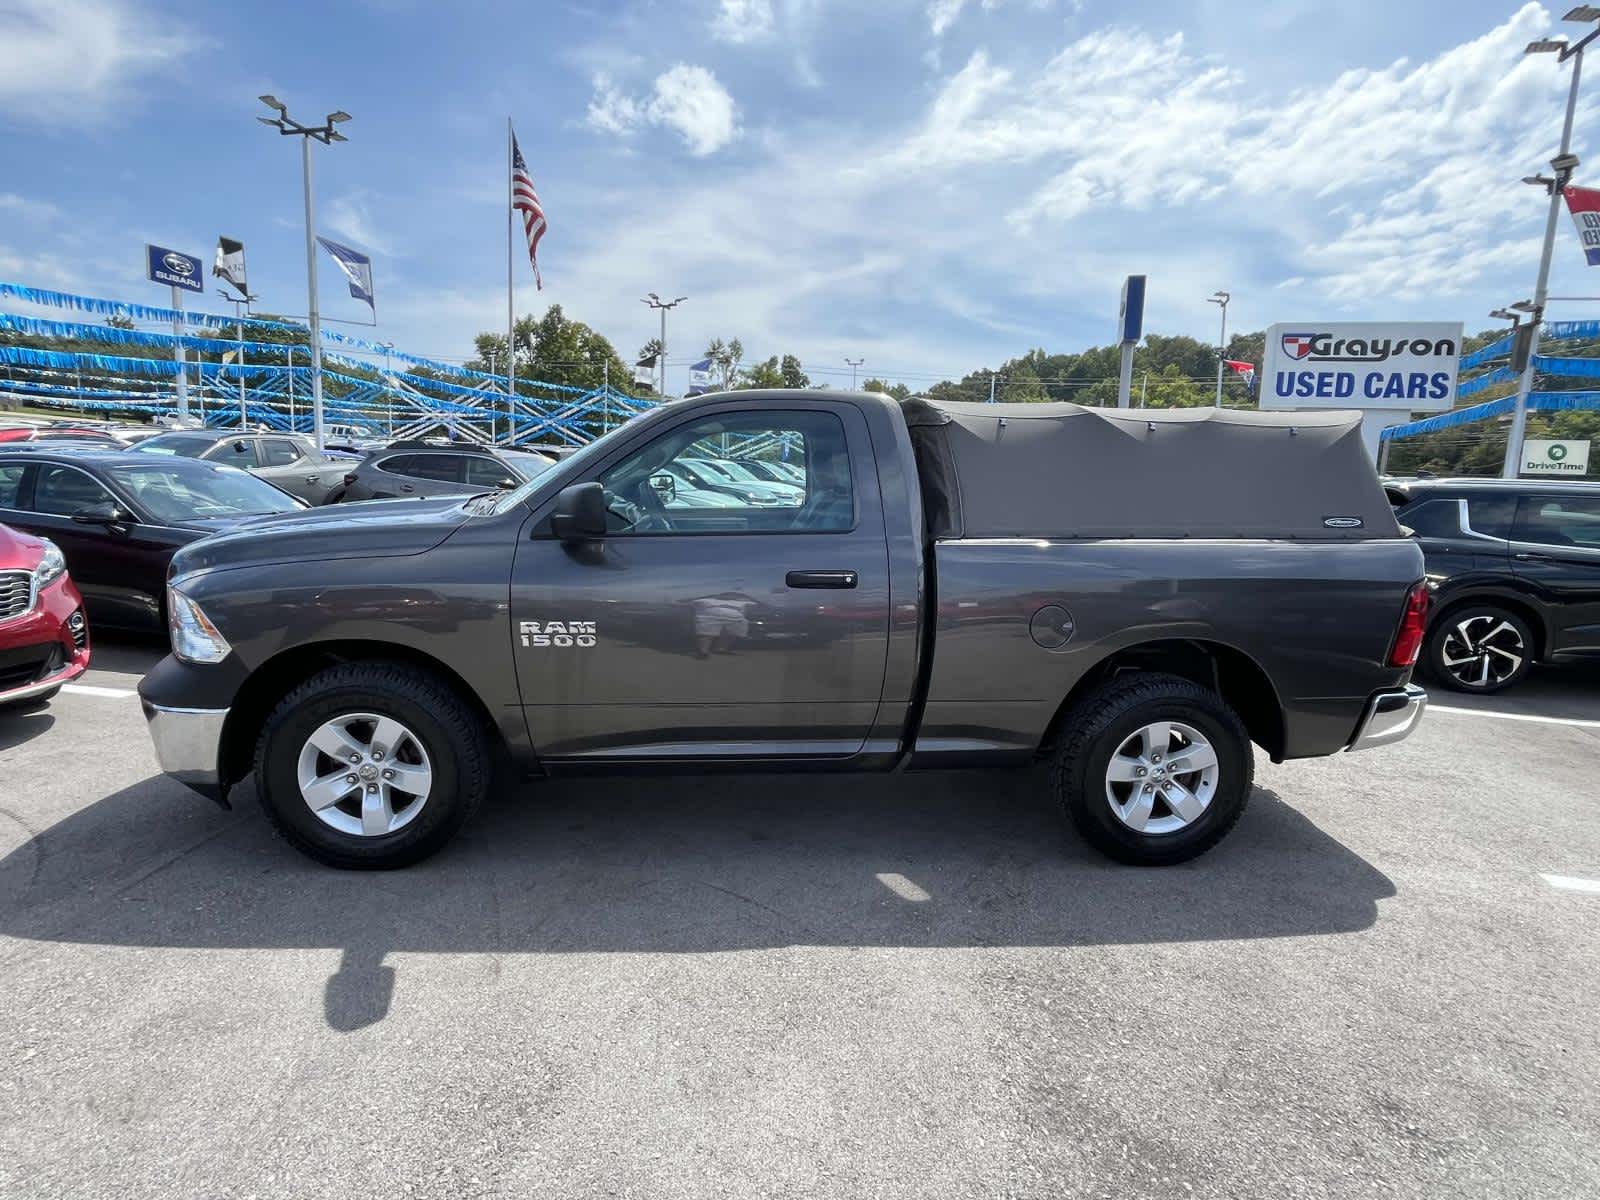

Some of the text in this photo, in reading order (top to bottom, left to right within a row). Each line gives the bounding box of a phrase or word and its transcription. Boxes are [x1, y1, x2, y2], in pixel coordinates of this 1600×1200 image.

[155, 270, 201, 289] SUBARU
[1308, 333, 1455, 362] Grayson
[1275, 371, 1450, 399] USED CARS
[1526, 462, 1584, 471] DriveTime
[520, 621, 597, 634] RAM
[520, 634, 597, 647] 1500
